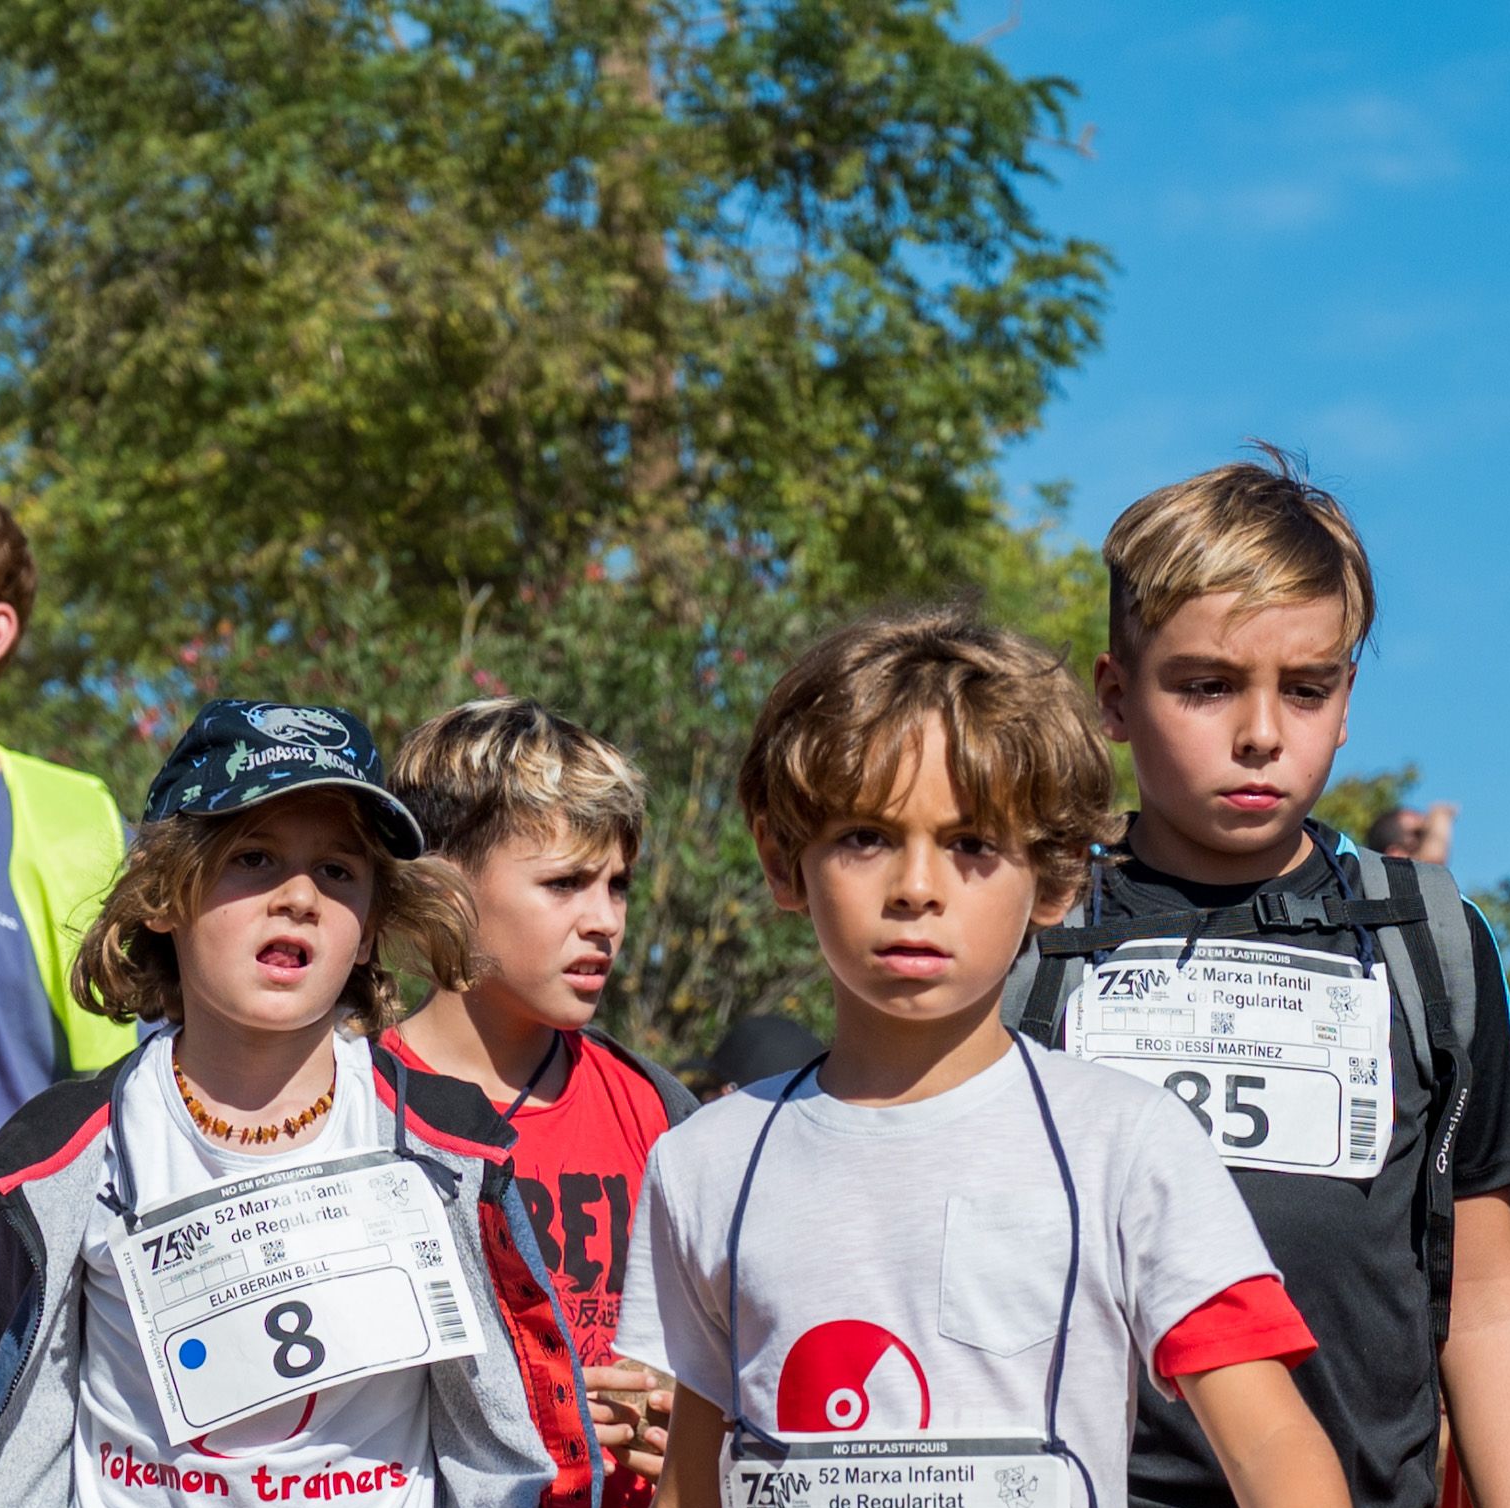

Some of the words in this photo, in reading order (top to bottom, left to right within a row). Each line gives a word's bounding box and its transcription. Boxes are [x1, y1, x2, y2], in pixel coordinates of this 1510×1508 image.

[246, 746, 313, 770] JURASSIC
[1207, 948, 1223, 958] EM
[1224, 949, 1291, 964] PLASTIFIQUIS
[1098, 969, 1137, 996] 75
[1203, 967, 1253, 985] Marxa
[1258, 971, 1311, 992] Infantil
[1212, 990, 1304, 1013] Regularitat
[1136, 1039, 1172, 1051] EROS
[1175, 1037, 1215, 1054] DESSÍ
[1217, 1040, 1283, 1059] MARTÍNEZ
[1163, 1070, 1269, 1149] 85
[1436, 1088, 1468, 1174] Quechua
[220, 1184, 238, 1198] NO
[238, 1179, 255, 1193] EM
[255, 1165, 323, 1187] PLASTIFIQUIS
[214, 1206, 236, 1225] 52
[239, 1191, 292, 1218] Marxa
[231, 1227, 252, 1244] de
[256, 1205, 351, 1239] Regulritat
[142, 1227, 183, 1271] 75
[209, 1287, 238, 1308] ELAI
[240, 1269, 293, 1296] BERIAIN
[264, 1299, 326, 1380] 8
[833, 1443, 851, 1455] NO
[851, 1443, 868, 1454] EM
[869, 1441, 948, 1454] PLASTIFIQUIS
[99, 1441, 229, 1497] Pokemon
[251, 1461, 410, 1502] trainers
[818, 1467, 840, 1485] 52
[845, 1466, 902, 1484] Marxa
[908, 1464, 975, 1483] Infantil
[741, 1472, 780, 1506] 75
